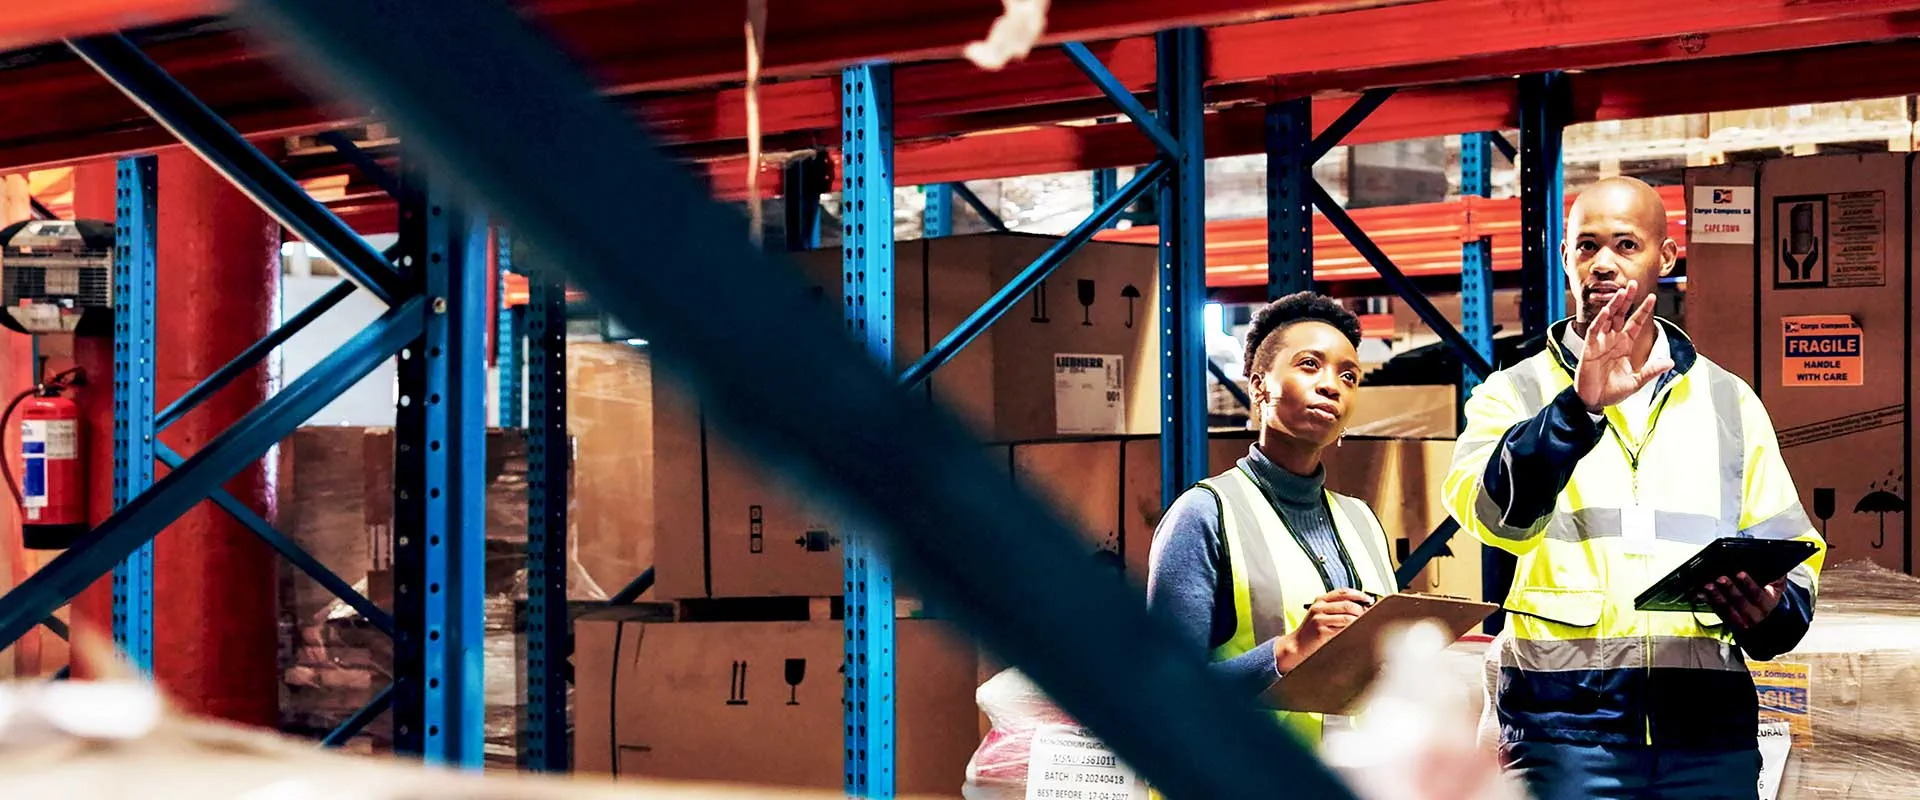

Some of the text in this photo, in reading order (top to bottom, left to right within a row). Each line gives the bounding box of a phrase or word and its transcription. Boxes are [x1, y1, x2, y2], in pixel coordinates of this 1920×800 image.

[1704, 224, 1740, 233] CAPE TOWN
[1789, 339, 1857, 353] FRAGILE
[1056, 357, 1104, 368] LIEBHERR
[1804, 361, 1841, 369] HANDLE
[1797, 373, 1848, 381] WITH CARE
[1044, 771, 1069, 781] BATCH
[1085, 774, 1125, 784] 20240418
[1037, 788, 1054, 798] BEST
[1056, 789, 1083, 800] BEFORE
